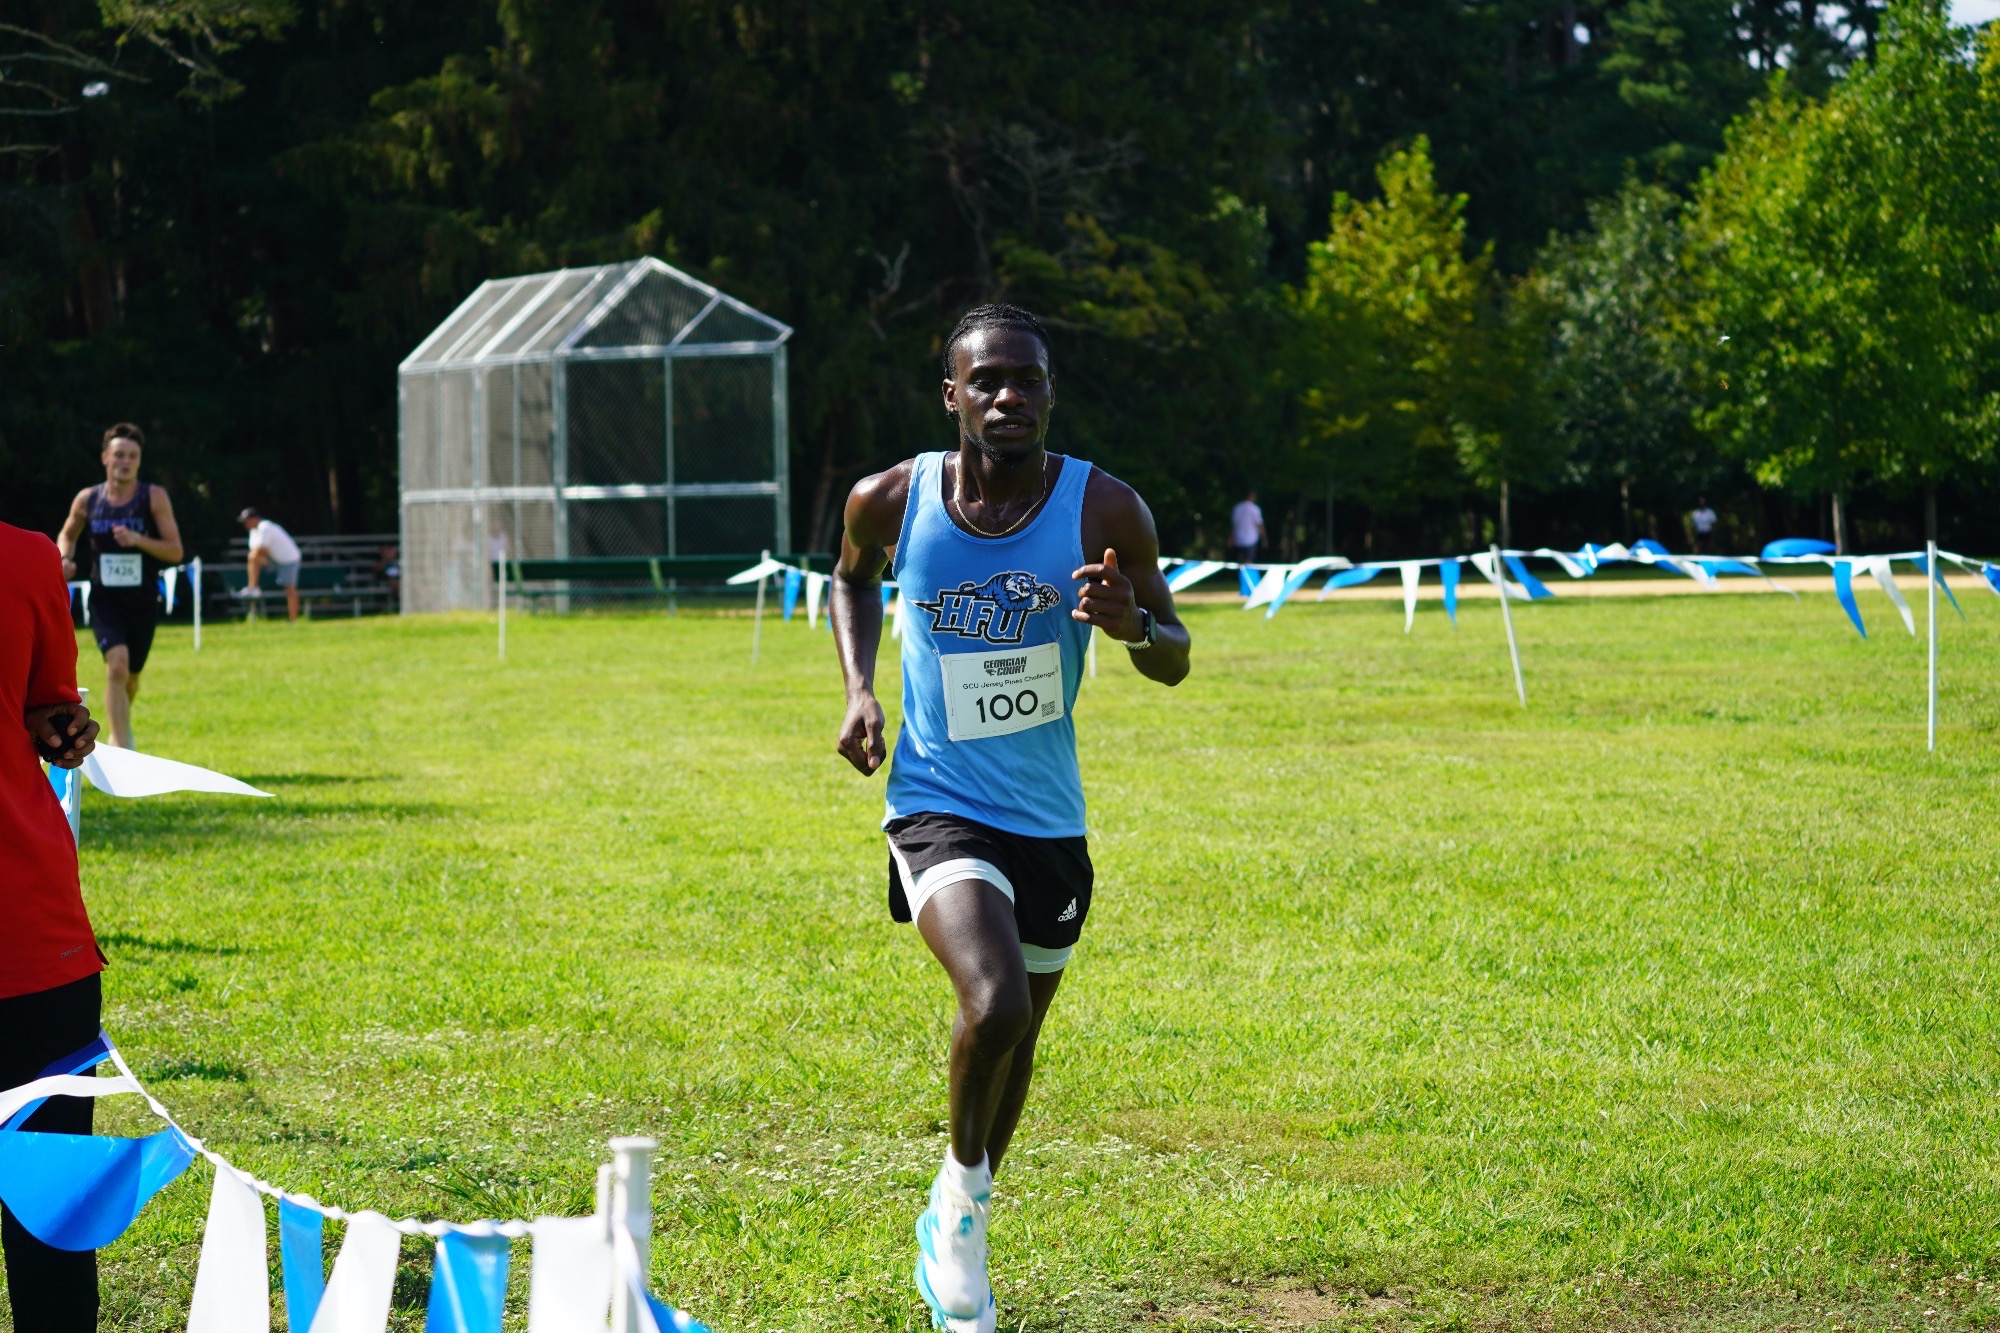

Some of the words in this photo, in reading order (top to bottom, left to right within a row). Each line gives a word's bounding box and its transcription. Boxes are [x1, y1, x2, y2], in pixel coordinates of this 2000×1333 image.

[932, 593, 1027, 644] HFU
[983, 656, 1028, 669] GEORGIAN
[996, 664, 1026, 676] COURT
[980, 680, 1004, 688] Jersey
[976, 690, 1038, 723] 100
